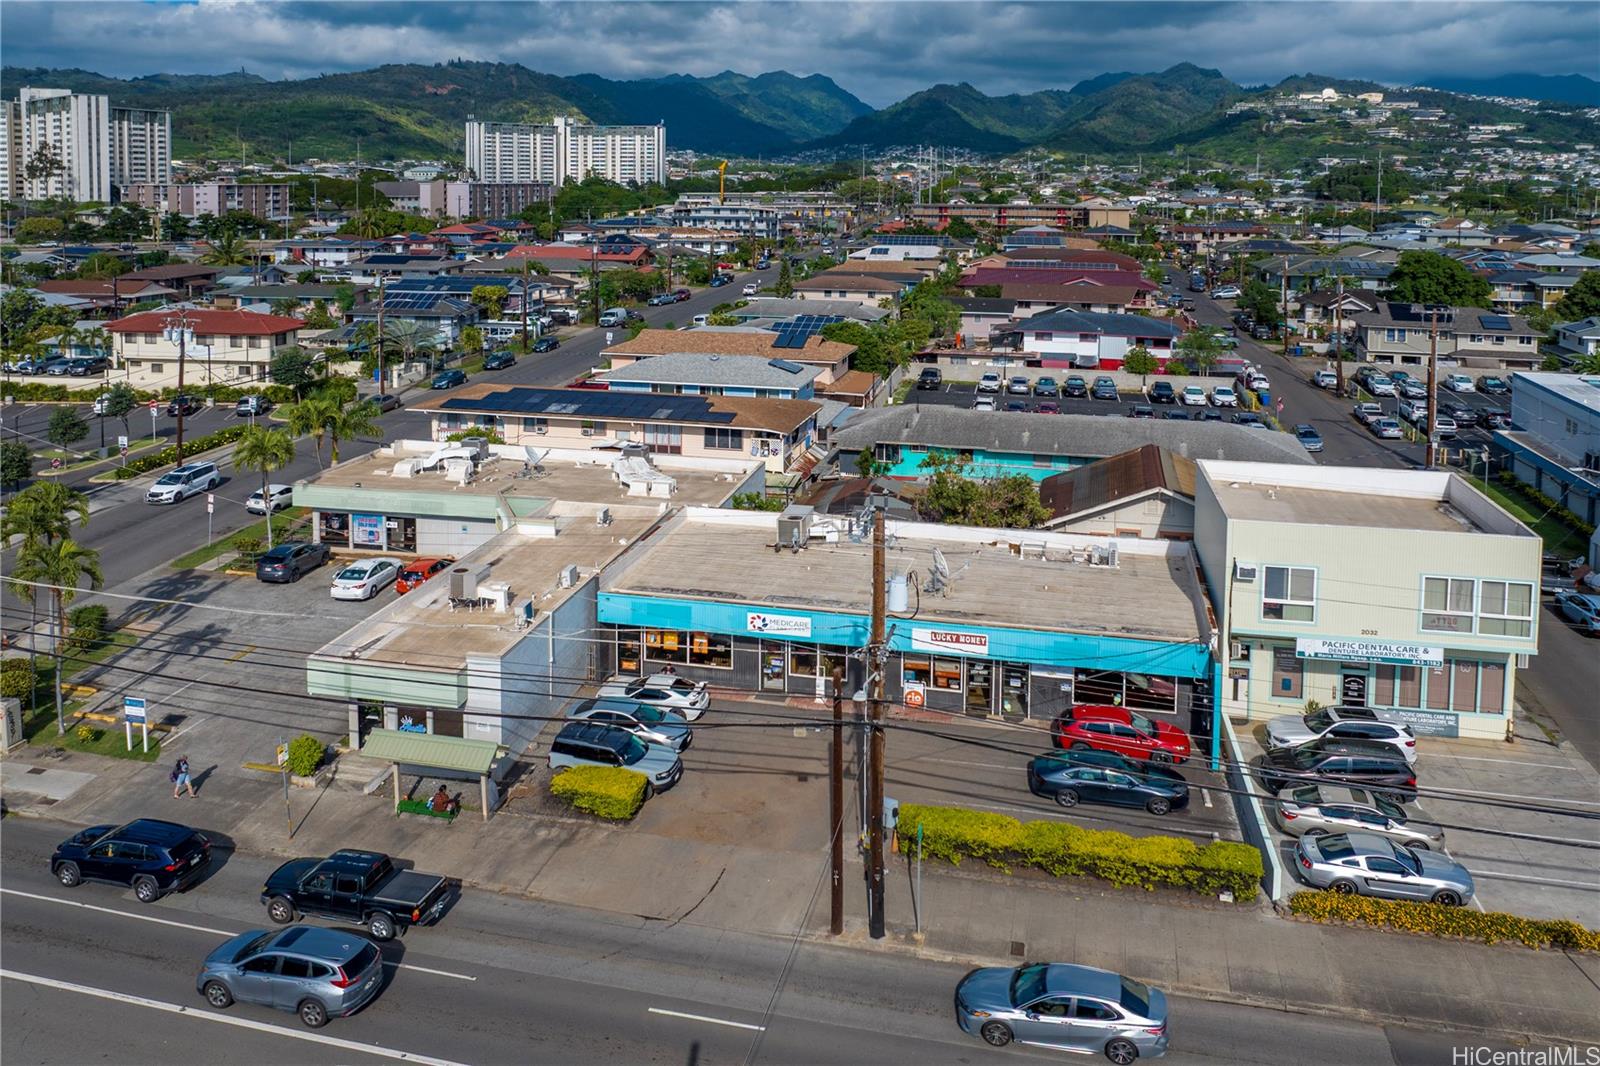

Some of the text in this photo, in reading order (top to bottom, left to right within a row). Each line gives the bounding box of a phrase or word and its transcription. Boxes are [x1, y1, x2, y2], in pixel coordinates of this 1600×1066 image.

[769, 619, 809, 628] MEDICARE
[931, 632, 986, 645] LUCKY MONEY
[1322, 641, 1430, 655] PACIFIC DENTAL CARE &
[1328, 648, 1360, 656] DENTURE
[906, 692, 921, 703] rio
